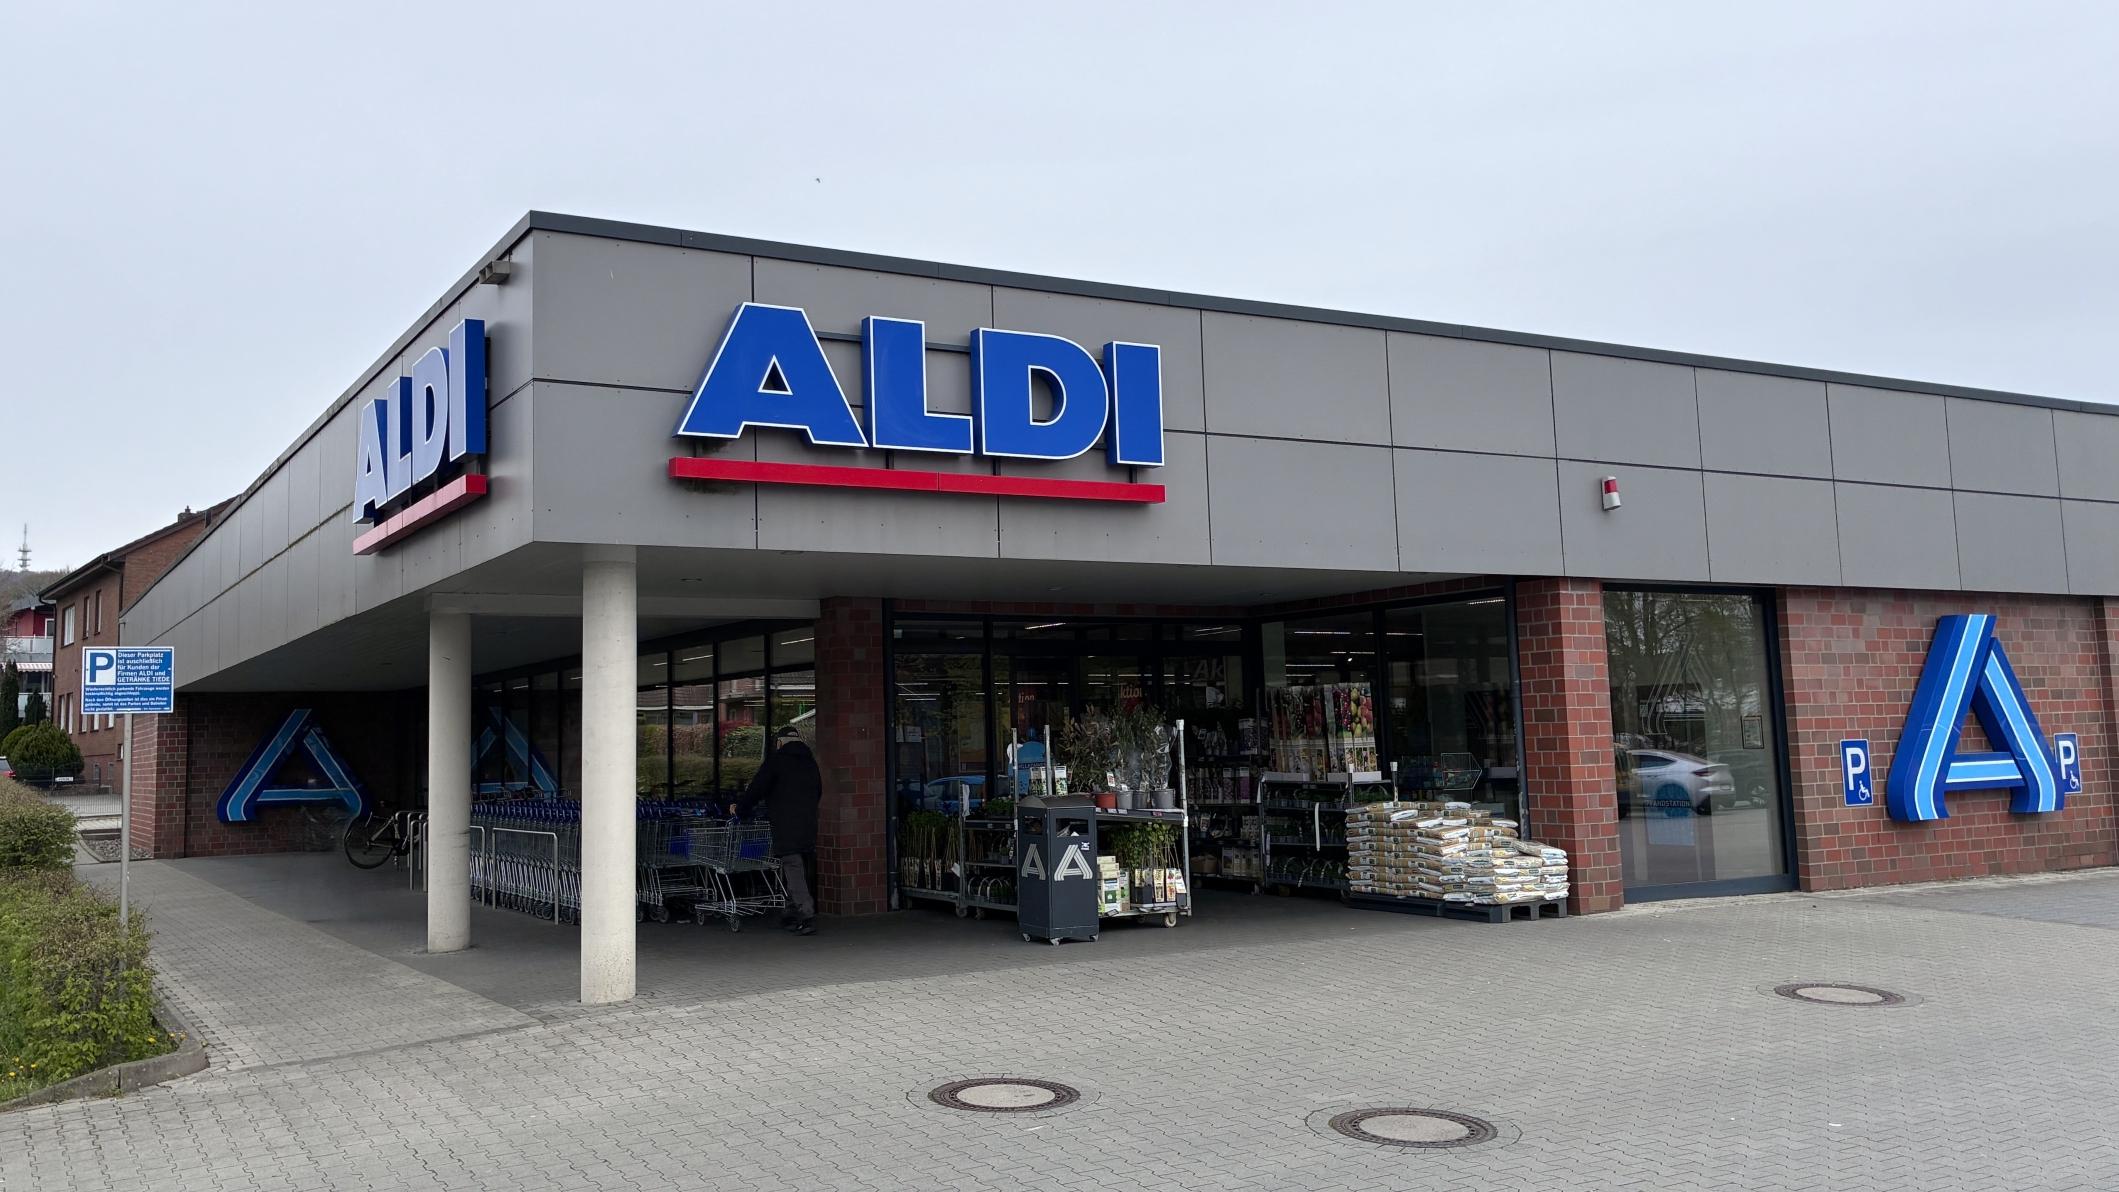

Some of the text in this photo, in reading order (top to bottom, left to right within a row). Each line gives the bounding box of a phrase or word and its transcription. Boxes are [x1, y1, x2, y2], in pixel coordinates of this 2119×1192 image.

[673, 302, 1165, 468] ALDI
[353, 319, 486, 524] ALDI
[89, 652, 115, 683] P
[1845, 747, 1866, 791] P
[2058, 740, 2075, 780] P
